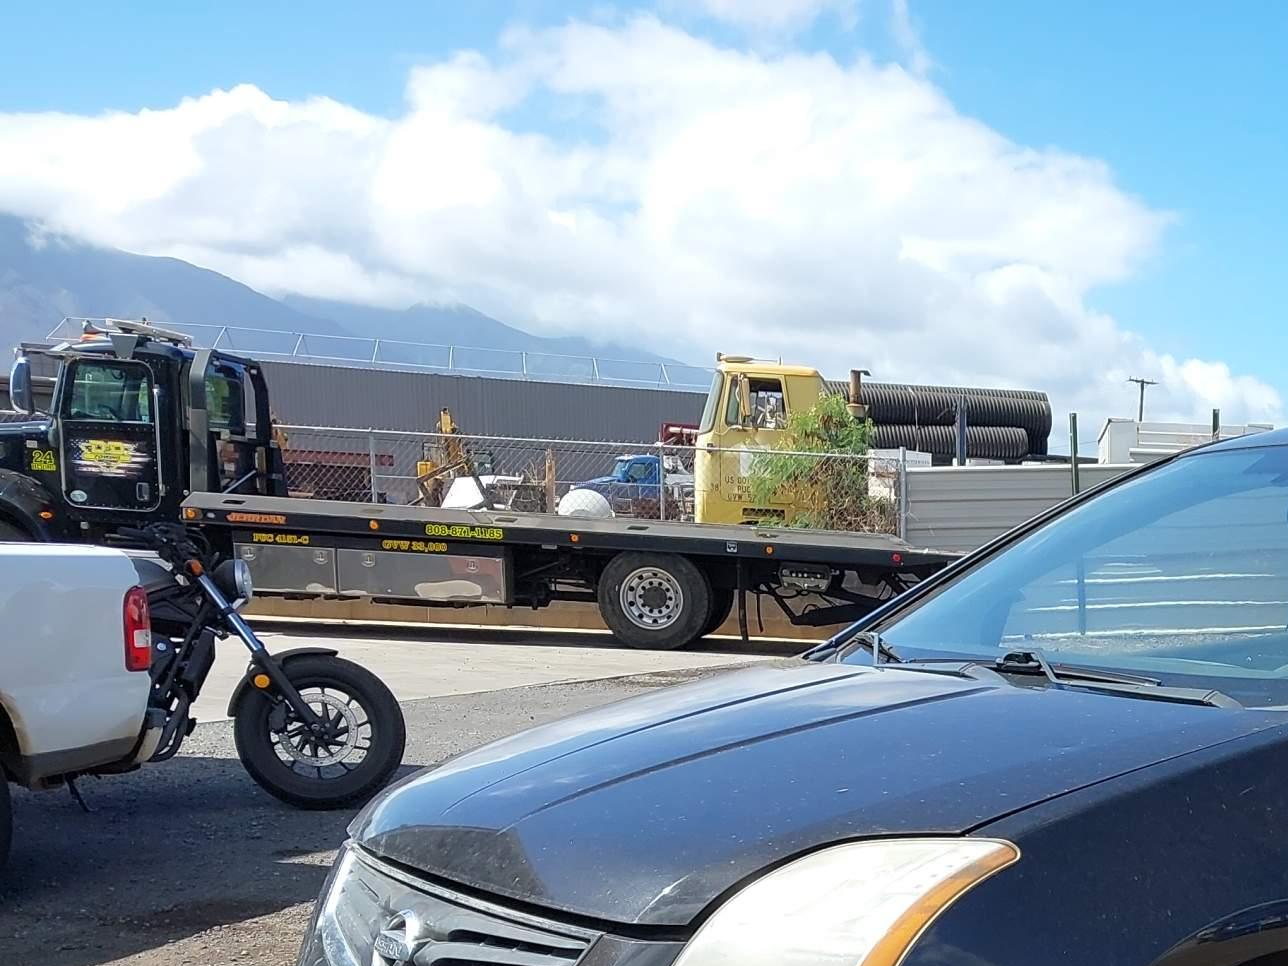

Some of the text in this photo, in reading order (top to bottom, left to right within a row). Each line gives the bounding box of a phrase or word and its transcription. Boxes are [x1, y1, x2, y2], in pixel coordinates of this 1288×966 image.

[32, 450, 55, 464] 24
[725, 476, 735, 484] US
[425, 524, 503, 539] 808-871-1185
[382, 540, 410, 550] GVW
